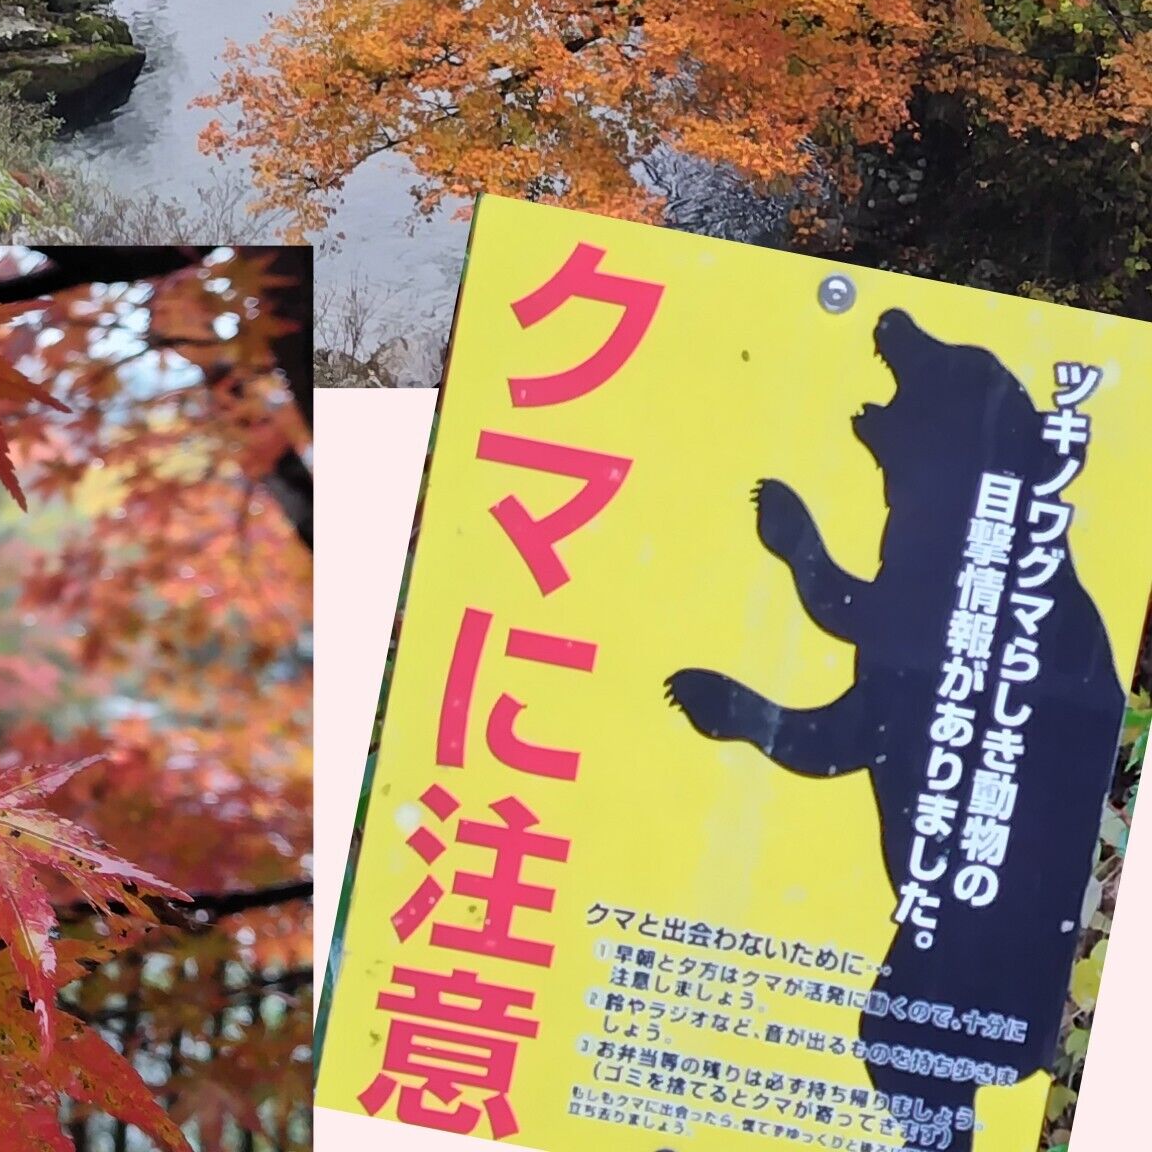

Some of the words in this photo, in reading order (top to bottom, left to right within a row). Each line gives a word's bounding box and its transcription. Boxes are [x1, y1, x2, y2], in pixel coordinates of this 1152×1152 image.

[357, 242, 665, 1140] クマに注意
[893, 472, 1021, 950] 目撃情報がありました。
[952, 364, 1099, 908] ツキノワグマらしき動物の
[603, 1014, 673, 1045] しょう。
